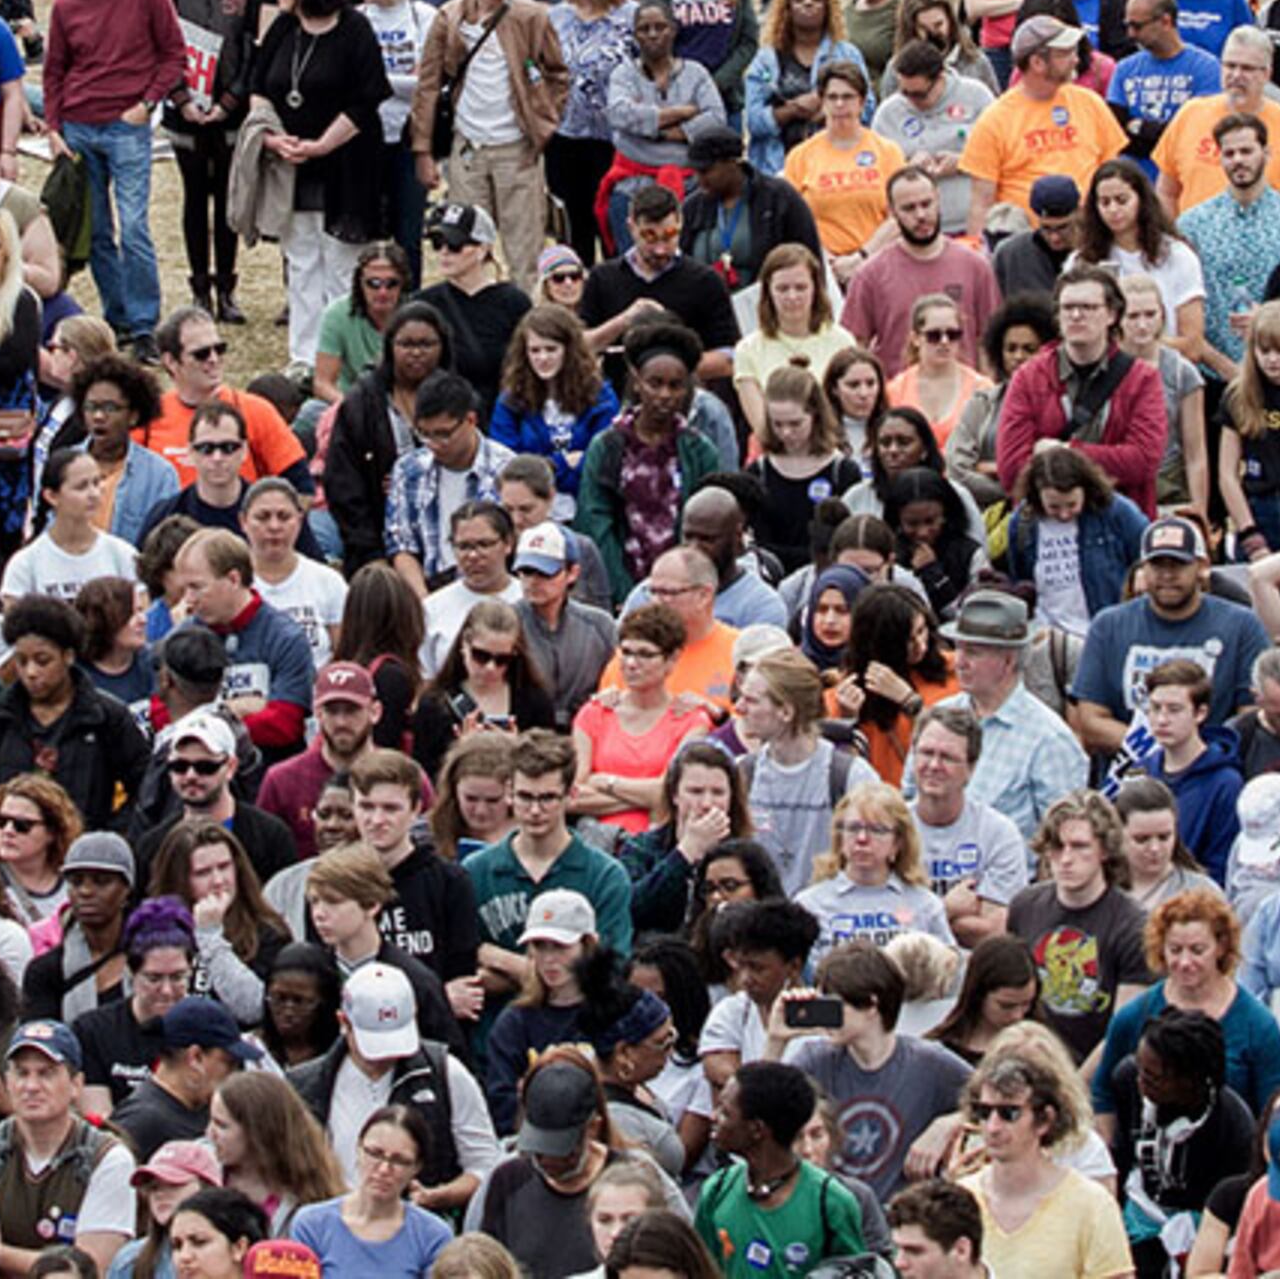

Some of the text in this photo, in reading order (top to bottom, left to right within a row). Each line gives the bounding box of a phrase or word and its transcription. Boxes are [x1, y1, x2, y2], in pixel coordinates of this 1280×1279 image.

[673, 1, 733, 26] MADE
[1024, 127, 1078, 149] STOP
[817, 170, 880, 188] STOP
[396, 929, 435, 955] END
